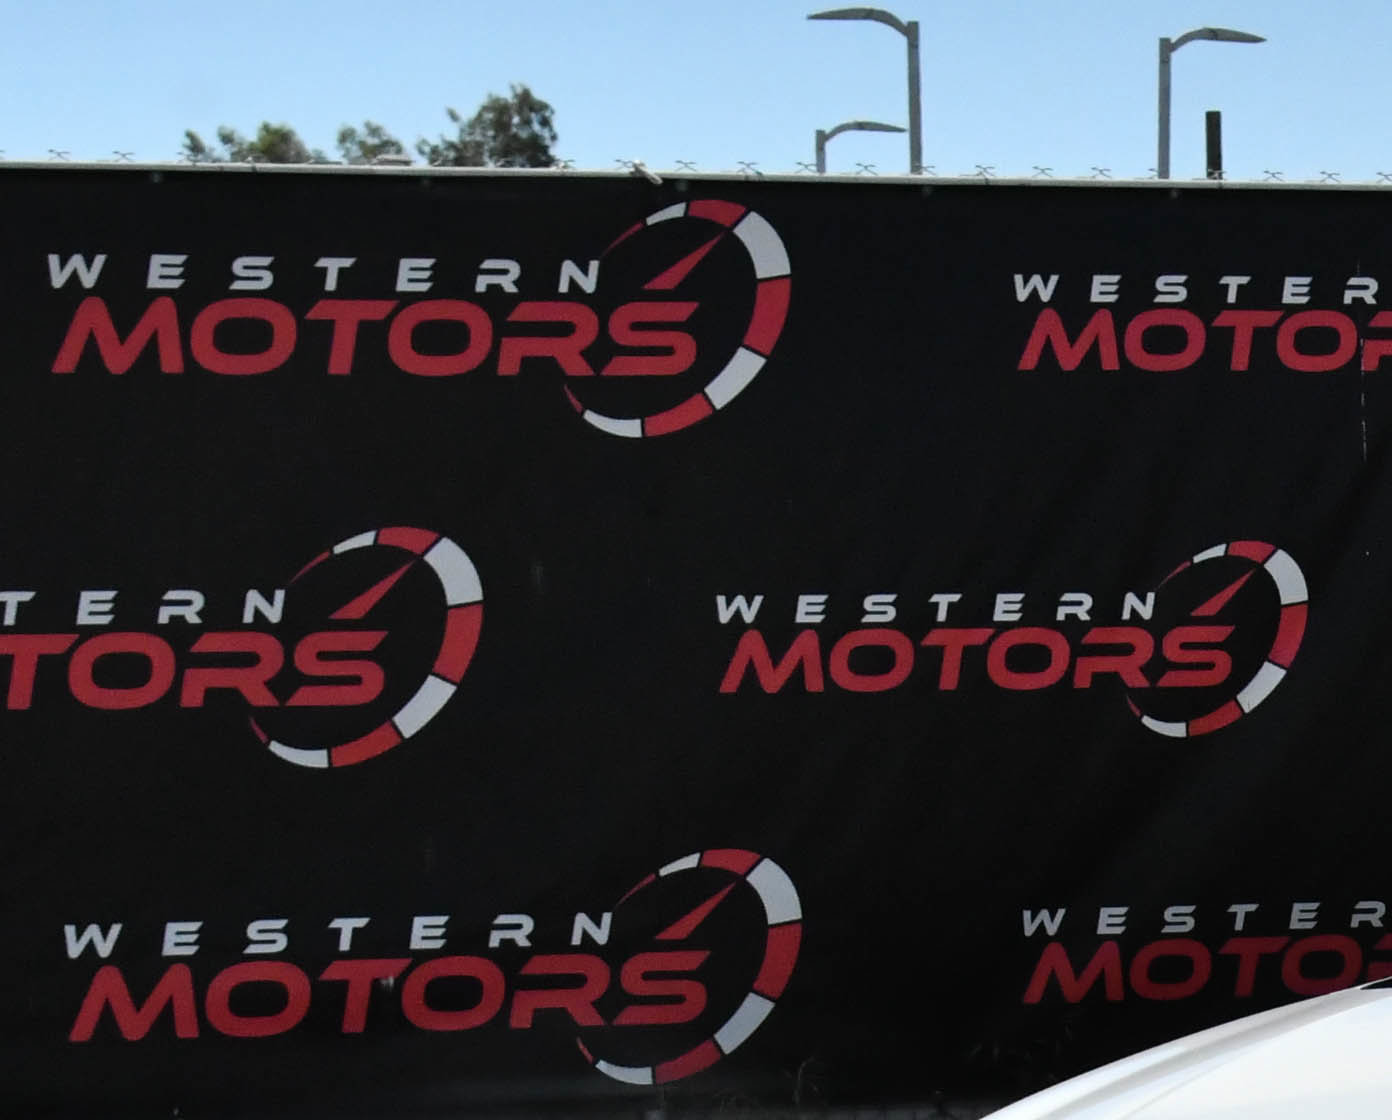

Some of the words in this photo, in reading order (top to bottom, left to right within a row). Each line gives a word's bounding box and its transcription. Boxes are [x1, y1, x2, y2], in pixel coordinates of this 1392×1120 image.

[48, 254, 599, 293] WESTERN
[52, 296, 699, 376] MOTORS
[0, 590, 285, 625] TERN
[717, 592, 1155, 623] WESTERN
[0, 631, 387, 710] TORS
[720, 626, 1235, 693] MOTORS
[65, 913, 611, 958] WESTERN
[70, 951, 711, 1043] MOTORS
